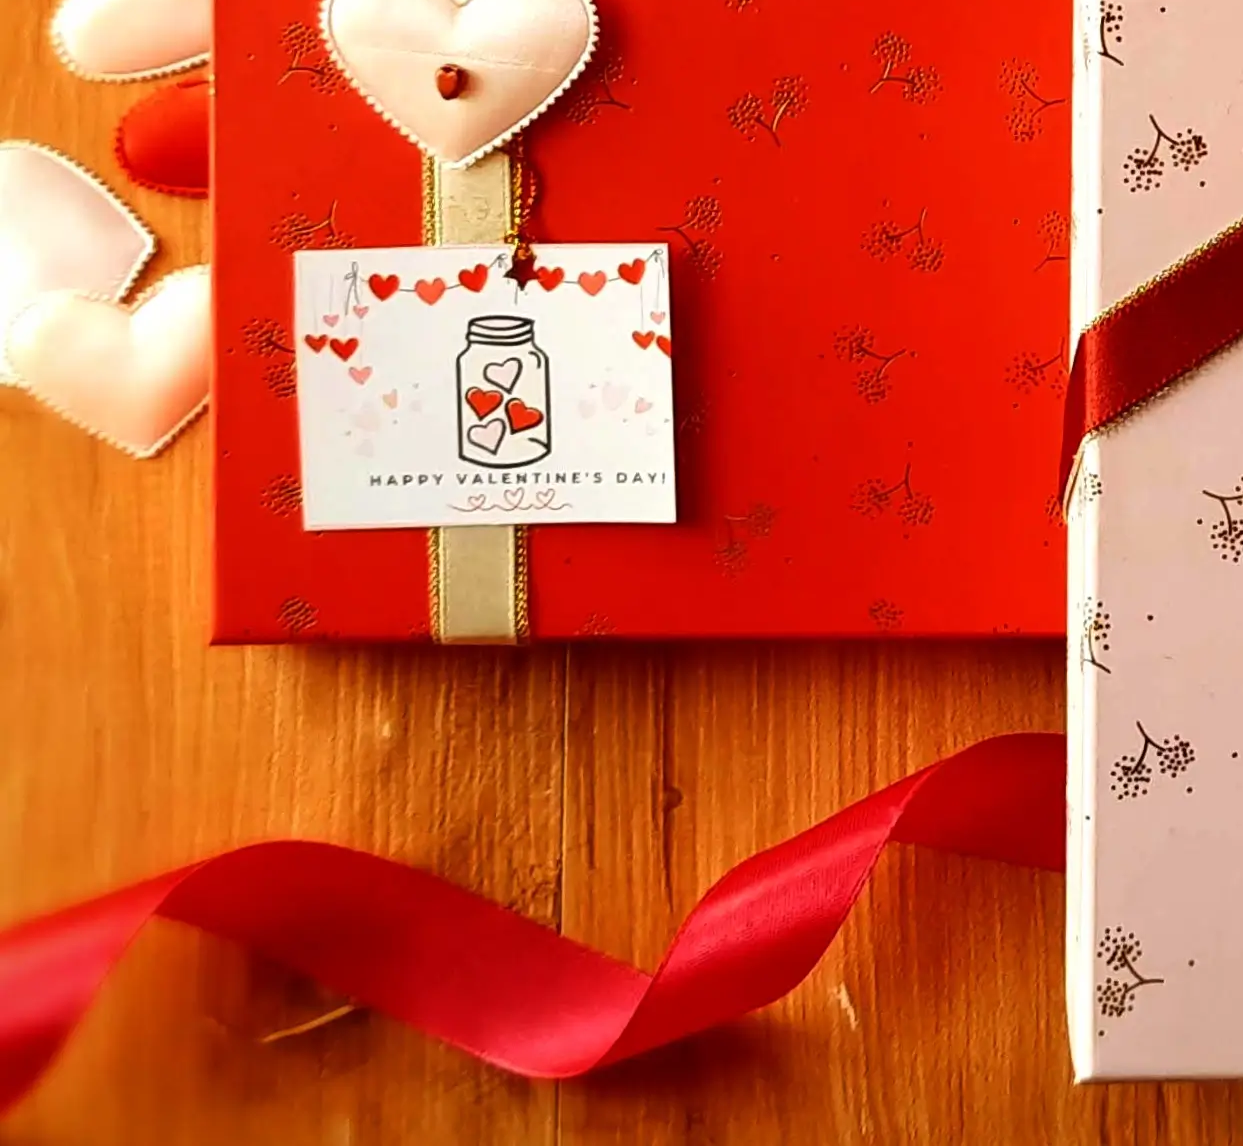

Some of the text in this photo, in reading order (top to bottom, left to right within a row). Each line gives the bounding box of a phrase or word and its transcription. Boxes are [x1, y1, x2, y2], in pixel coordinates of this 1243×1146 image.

[369, 471, 667, 487] HAPPY VALENTINE'S DAY!
